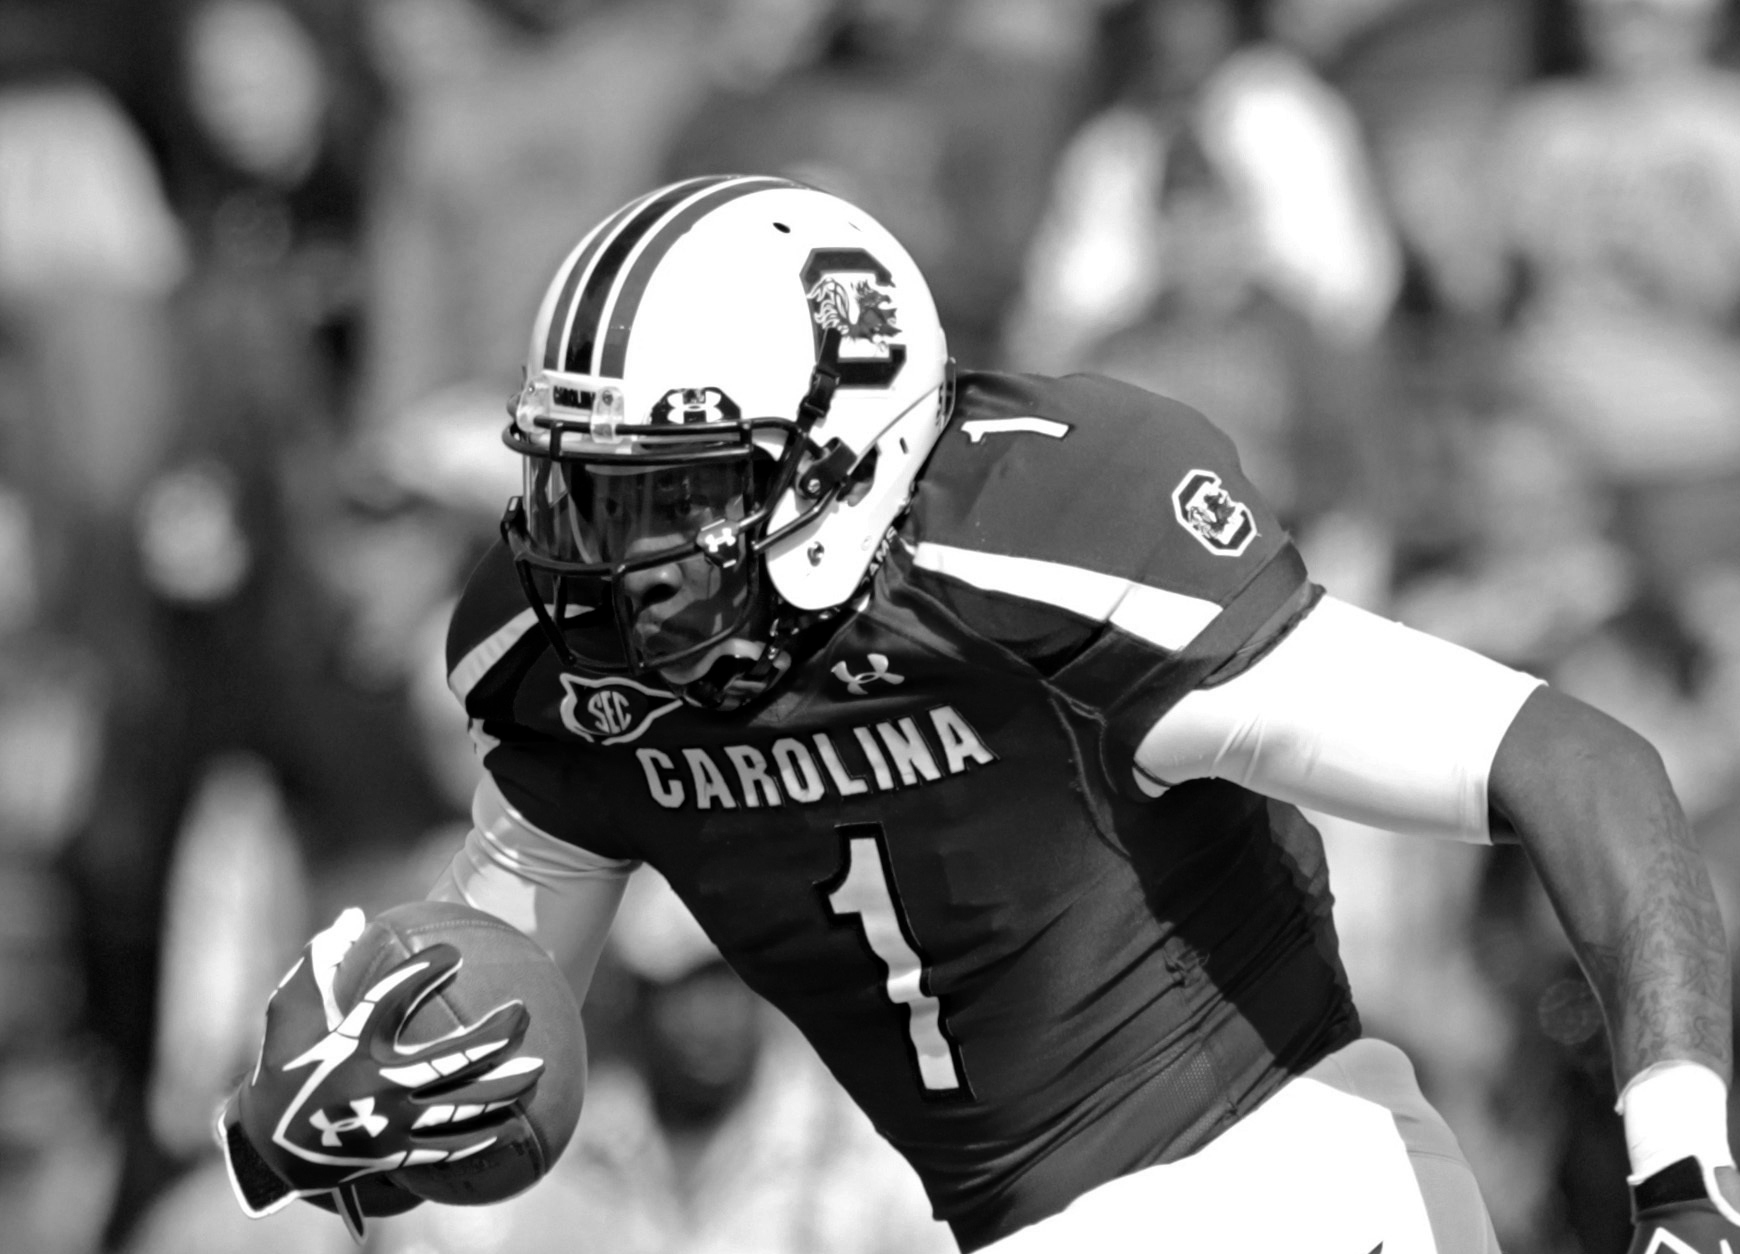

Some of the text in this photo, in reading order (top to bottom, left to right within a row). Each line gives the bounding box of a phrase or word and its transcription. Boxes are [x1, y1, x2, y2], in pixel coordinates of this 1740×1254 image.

[587, 690, 632, 734] SEC
[636, 705, 997, 809] CAROLINA
[818, 826, 970, 1095] 1
